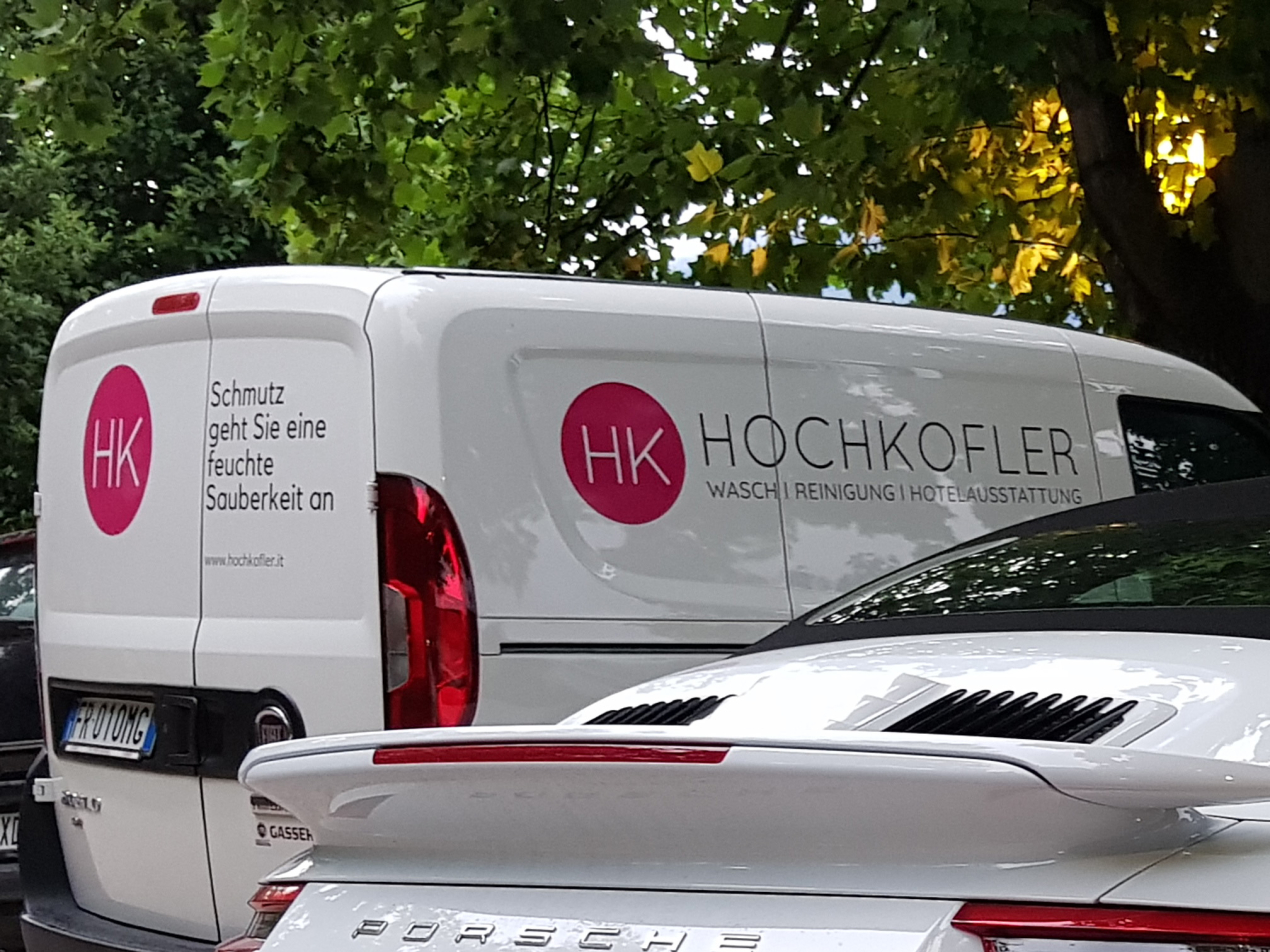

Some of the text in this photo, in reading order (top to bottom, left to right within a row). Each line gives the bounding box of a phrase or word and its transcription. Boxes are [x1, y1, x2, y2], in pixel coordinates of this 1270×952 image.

[210, 380, 285, 407] Schmutz
[209, 412, 327, 447] geht Sie eine
[698, 412, 1078, 476] HOCHKOFLER
[92, 417, 143, 488] HK
[208, 448, 274, 477] feuchte
[581, 424, 671, 486] HK
[206, 482, 335, 511] Sauberkeit an
[706, 480, 1083, 505] WASCH REINIGUNG HOTELAUSSTATTUNG
[204, 553, 285, 568] www.hochkofler.it
